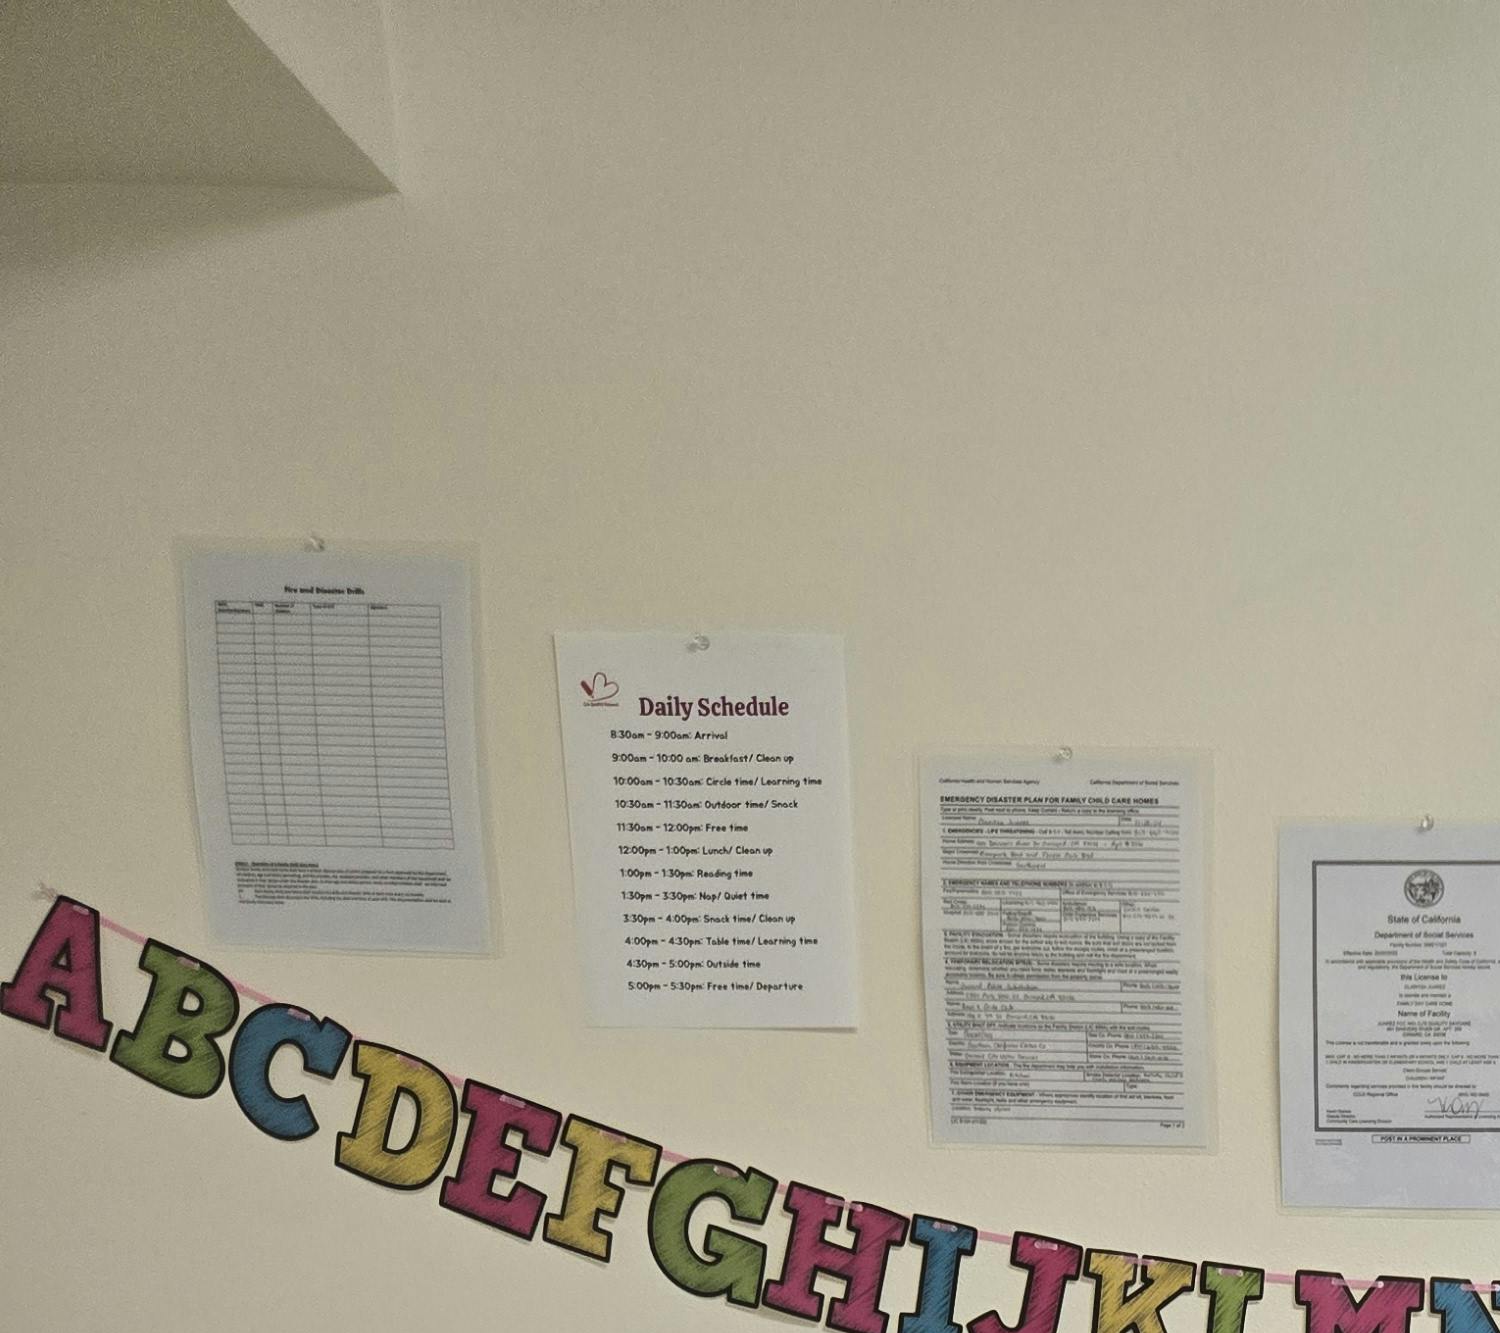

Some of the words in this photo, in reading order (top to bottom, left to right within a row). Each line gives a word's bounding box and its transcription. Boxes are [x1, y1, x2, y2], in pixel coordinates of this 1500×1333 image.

[638, 696, 694, 721] Daily
[698, 696, 789, 717] Schedule
[694, 731, 728, 740] Arrival
[756, 753, 781, 762] Clean
[783, 755, 794, 765] up
[706, 777, 732, 786] Circle
[760, 776, 800, 788] Learning
[803, 777, 822, 785] time
[704, 800, 742, 809] Outdoor
[771, 800, 798, 808] Snack
[1024, 796, 1043, 804] PLAN
[1111, 797, 1131, 805] CARE
[705, 823, 727, 832] Free
[729, 824, 748, 832] time
[735, 845, 761, 855] Clean
[762, 848, 773, 857] up
[697, 869, 732, 880] Reading
[734, 869, 753, 878] time
[724, 891, 747, 901] Quiet
[750, 892, 770, 900] time
[703, 914, 730, 923] Snack
[758, 913, 784, 923] Clean
[785, 916, 796, 925] up
[1387, 914, 1409, 925] State
[1411, 914, 1420, 925] of
[1421, 914, 1461, 925] California
[1374, 931, 1413, 940] Department
[1414, 931, 1422, 939] of
[1423, 931, 1444, 939] Social
[1445, 931, 1474, 939] Services
[706, 937, 729, 946] Table
[758, 936, 796, 948] Learning
[799, 937, 818, 945] time
[706, 959, 739, 968] Outside
[742, 960, 761, 968] time
[707, 982, 728, 991] Free
[756, 981, 803, 993] Departure
[1398, 1010, 1418, 1018] Name
[1419, 1010, 1427, 1018] of
[1427, 1010, 1451, 1020] Facility
[1443, 1135, 1462, 1143] PLACE
